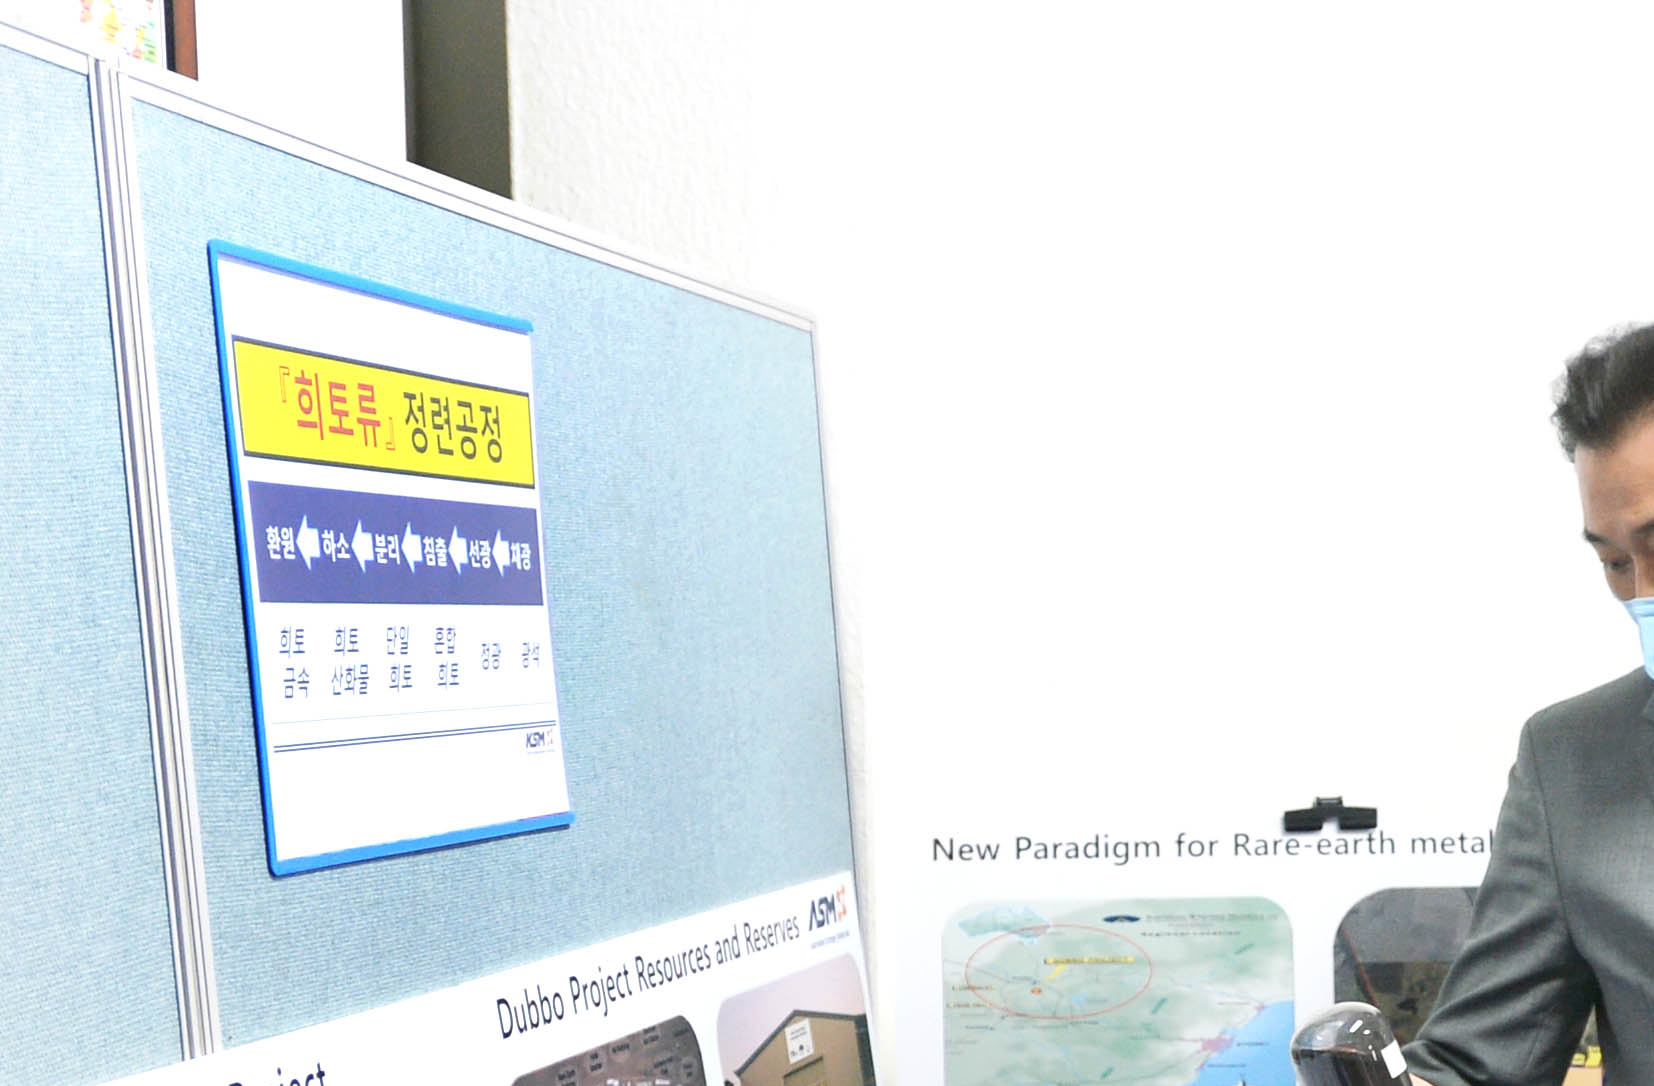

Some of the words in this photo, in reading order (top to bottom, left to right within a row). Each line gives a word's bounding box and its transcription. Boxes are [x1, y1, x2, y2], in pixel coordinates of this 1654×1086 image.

[403, 391, 503, 463] 정련공정
[265, 524, 296, 560] 환원
[321, 529, 351, 563] 하소
[374, 533, 400, 565] 분리
[422, 536, 448, 567] 침출
[469, 539, 492, 569] 선광
[510, 541, 531, 571] 채광
[279, 625, 306, 658] 희토
[333, 625, 359, 657] 희토
[384, 624, 410, 655] 단일
[434, 624, 456, 655] 혼합
[481, 642, 501, 670] 정광
[521, 641, 540, 669] 광석
[283, 666, 310, 699] 금속
[331, 663, 370, 696] 산화물
[388, 663, 413, 693] 희토
[437, 660, 460, 691] 희토
[932, 836, 1000, 862] New
[1015, 833, 1161, 866] Paradigm
[1175, 832, 1219, 858] for
[1233, 829, 1396, 857] Rare-earth
[807, 892, 838, 932] ASM
[496, 983, 565, 1040] Dubbo
[568, 962, 633, 1017] Project
[634, 943, 712, 992] Resources
[715, 923, 741, 965] and
[743, 915, 800, 956] Reserves
